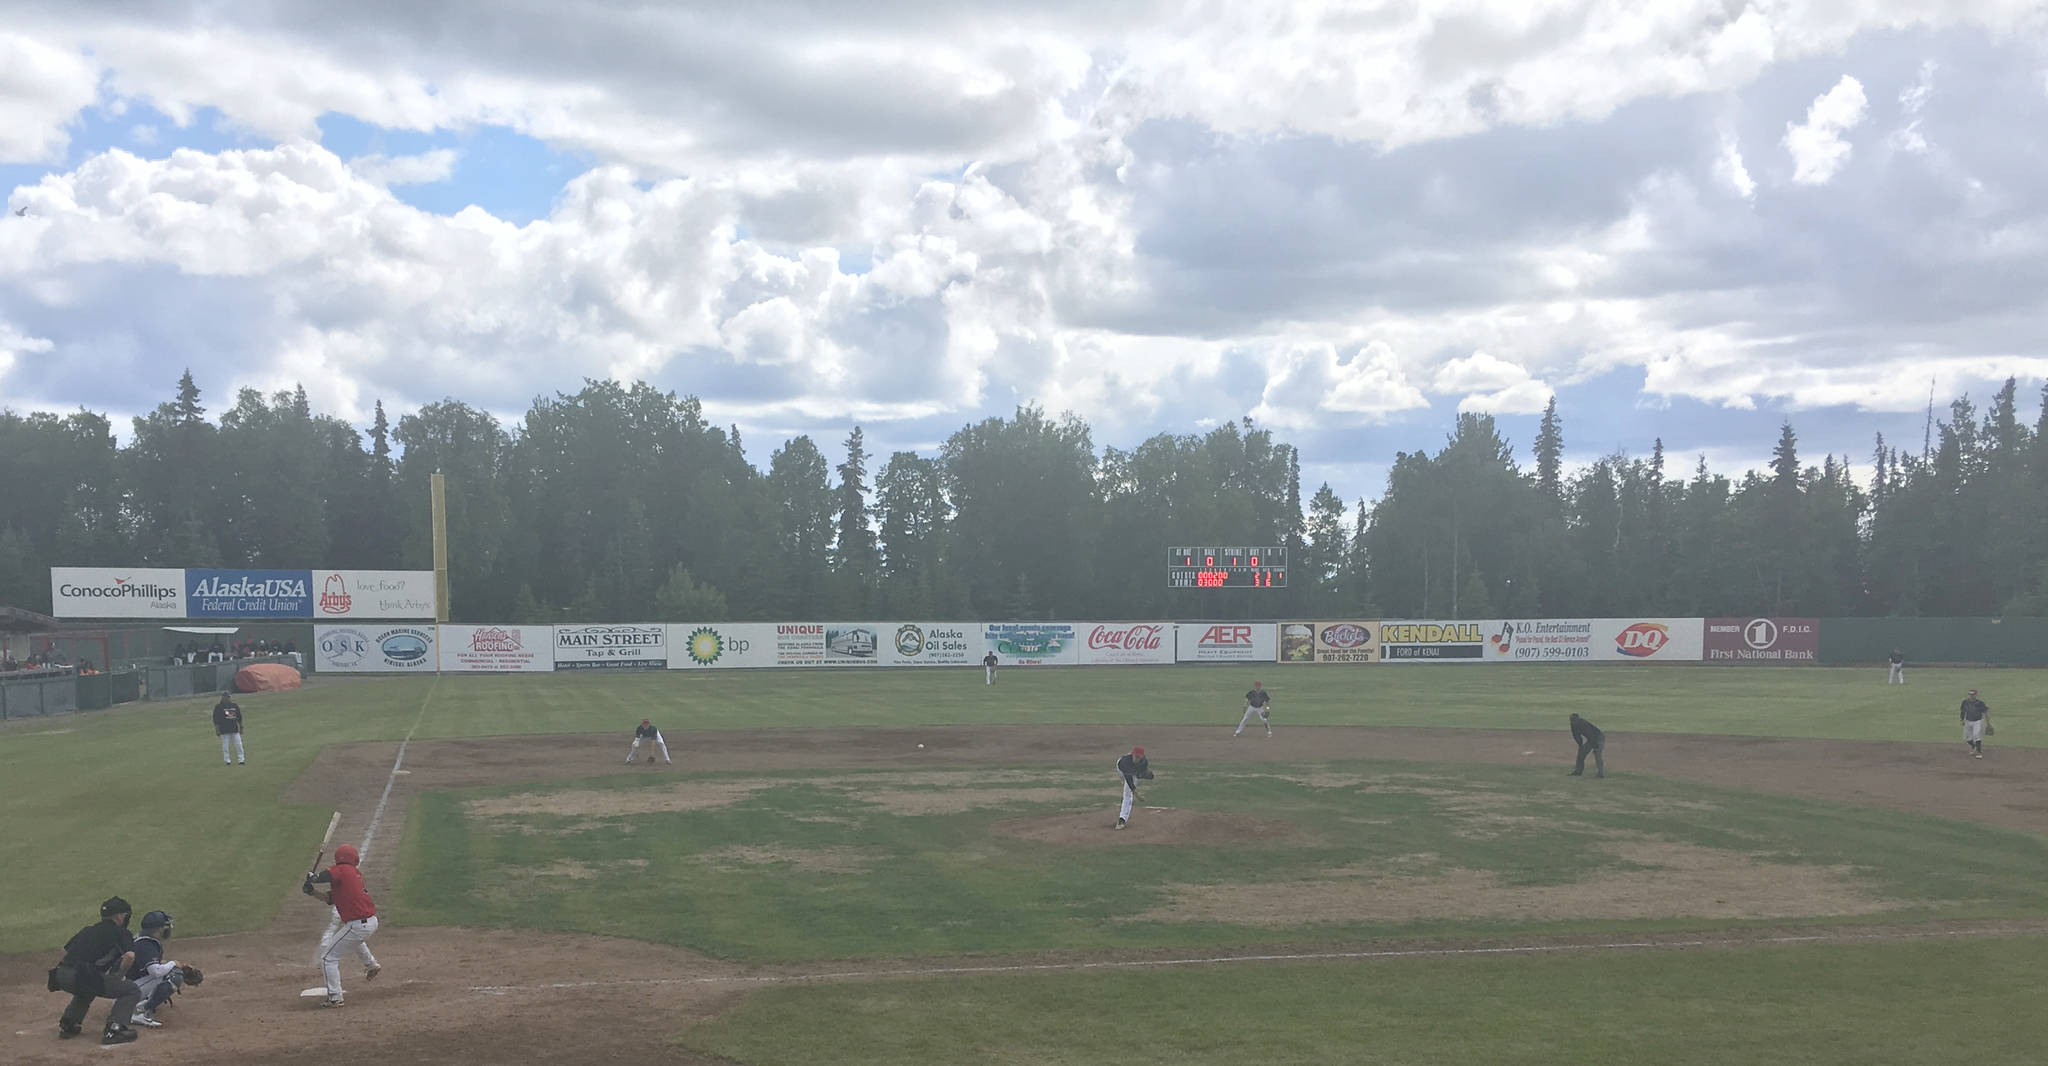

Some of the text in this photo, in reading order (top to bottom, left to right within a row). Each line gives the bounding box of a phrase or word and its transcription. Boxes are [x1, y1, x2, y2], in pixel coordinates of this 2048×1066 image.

[1186, 557, 1191, 566] 1
[1206, 556, 1214, 567] 0
[1233, 557, 1237, 566] 1
[1250, 556, 1258, 566] 0
[60, 583, 176, 600] ConocoPhillips
[192, 576, 306, 598] AlaskaUSA
[357, 580, 405, 592] love food?
[150, 601, 176, 609] Alaska
[202, 599, 298, 612] Federal Credit Union
[379, 600, 404, 611] think
[777, 625, 823, 634] UNIQUE
[1516, 622, 1590, 633] K.O. Entertainment
[930, 629, 963, 638] Alaska
[1088, 625, 1164, 650] Coca-Cola
[1199, 626, 1252, 643] AER
[1381, 624, 1483, 643] KENDALL
[1753, 623, 1768, 644] 1
[560, 634, 661, 645] MAIN STREET
[729, 637, 749, 652] bp
[1623, 630, 1662, 650] DQ
[475, 642, 513, 651] ROOFING
[926, 641, 967, 650] Oil Sales
[1397, 648, 1412, 656] FORD
[1515, 647, 1589, 658] (907) 599-0103
[1710, 649, 1813, 659] First National Bank
